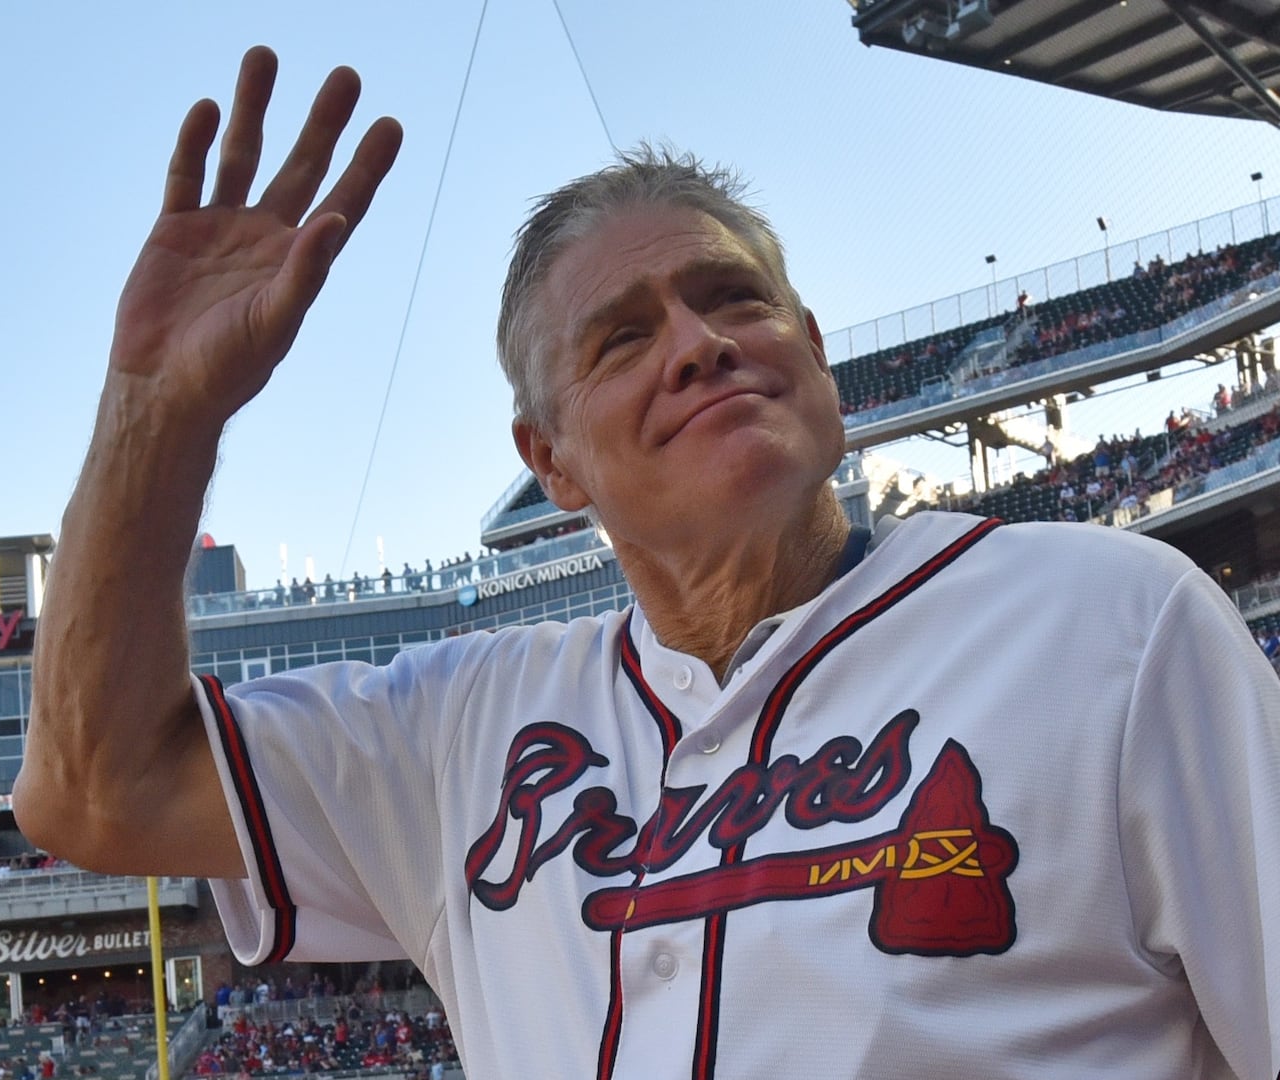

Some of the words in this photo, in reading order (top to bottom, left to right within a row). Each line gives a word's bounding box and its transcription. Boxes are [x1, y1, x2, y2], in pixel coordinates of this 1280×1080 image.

[477, 574, 534, 600] KONICA
[537, 554, 603, 584] MINOLTA
[464, 708, 919, 912] Braves
[94, 930, 151, 950] BULLET
